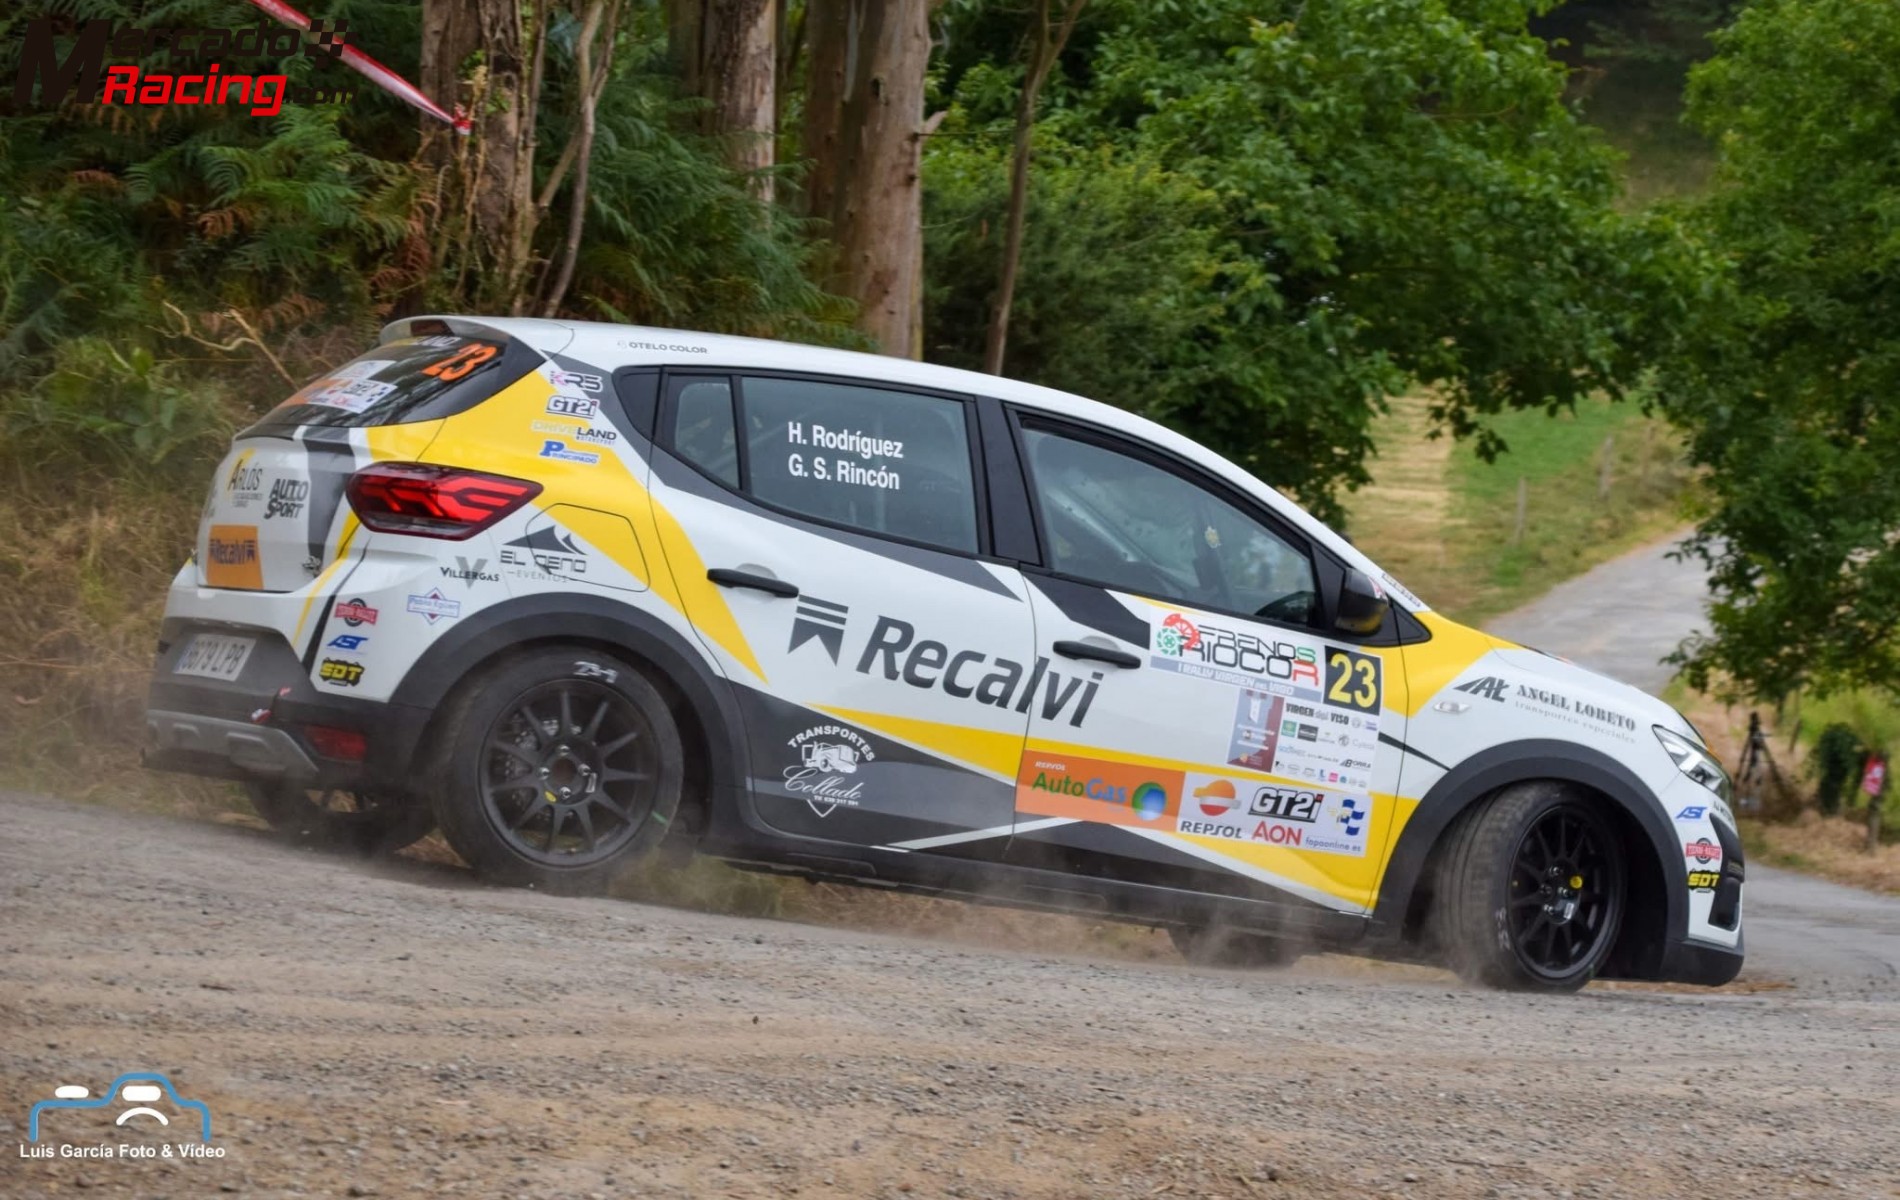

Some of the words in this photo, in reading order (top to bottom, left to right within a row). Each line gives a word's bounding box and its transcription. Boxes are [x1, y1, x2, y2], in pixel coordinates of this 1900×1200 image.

[628, 342, 668, 351] OTELO
[669, 344, 708, 354] COLOR
[546, 395, 599, 420] GT2i
[788, 421, 807, 445] H.
[812, 424, 904, 459] Rodríguez
[788, 453, 808, 477] G.
[813, 456, 831, 481] S.
[837, 460, 900, 490] Rincón
[264, 498, 304, 520] SPORT
[500, 550, 526, 566] EL
[440, 566, 500, 583] VILLERGAS
[855, 615, 1104, 728] Recalvi
[1215, 670, 1255, 687] VIRGEN
[1328, 652, 1378, 709] 23
[1285, 702, 1315, 717] VIRGEN
[1330, 712, 1350, 726] VISO
[1517, 684, 1570, 711] ANGEL
[1574, 700, 1636, 732] LOBETO
[787, 725, 876, 762] TRANSPORTES
[783, 765, 865, 800] Collado
[1031, 771, 1128, 805] AutoGas
[1248, 786, 1324, 823] GT2i
[1180, 820, 1243, 840] REPSOL
[1252, 820, 1303, 847] AON
